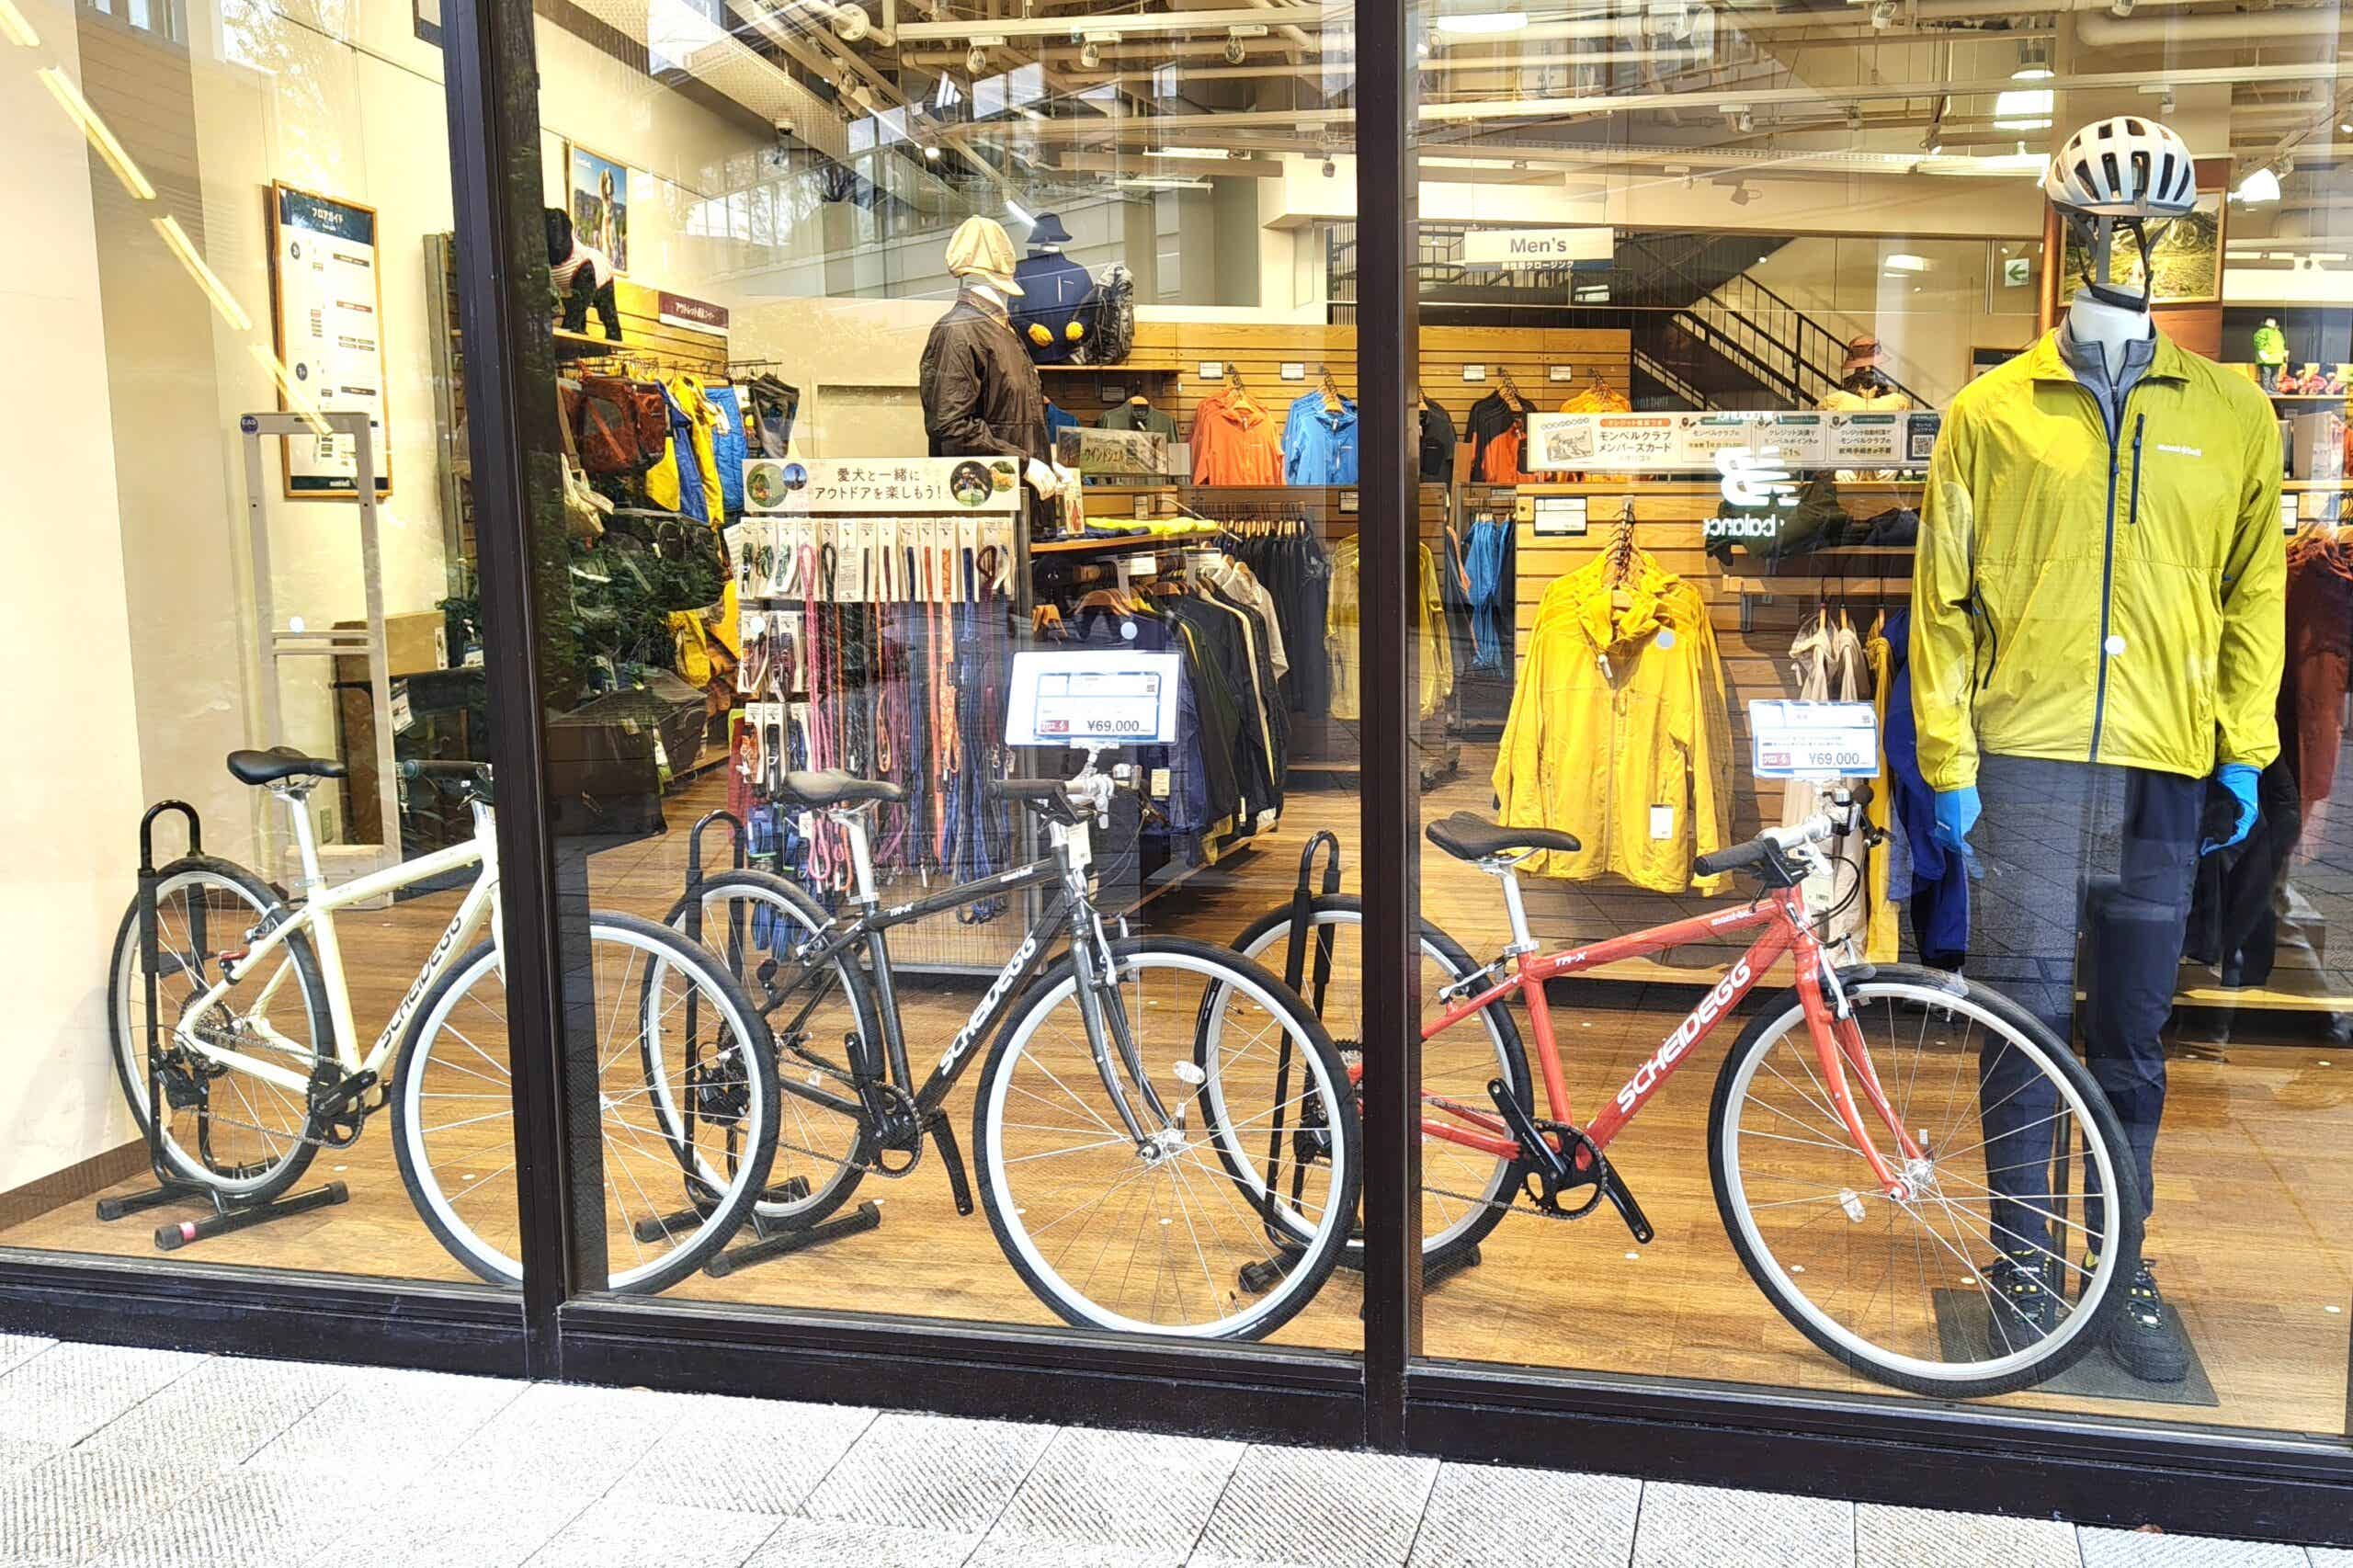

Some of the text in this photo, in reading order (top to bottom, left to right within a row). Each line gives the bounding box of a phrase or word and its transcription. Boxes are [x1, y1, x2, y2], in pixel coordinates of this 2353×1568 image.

[1510, 237, 1567, 253] Men's
[1599, 431, 1671, 440] モンベルクラブ
[1599, 443, 1671, 453] メンバーズカード
[836, 466, 920, 483] 愛犬と一緒に
[814, 486, 942, 501] アウトドアを楽しもう!
[1087, 720, 1140, 733] ¥69,000
[1808, 752, 1860, 767] ¥69,000
[1555, 950, 1588, 967] TR-X
[939, 930, 1036, 1075] SCHEIDEGG
[1616, 956, 1752, 1114] SCHEIDEGG
